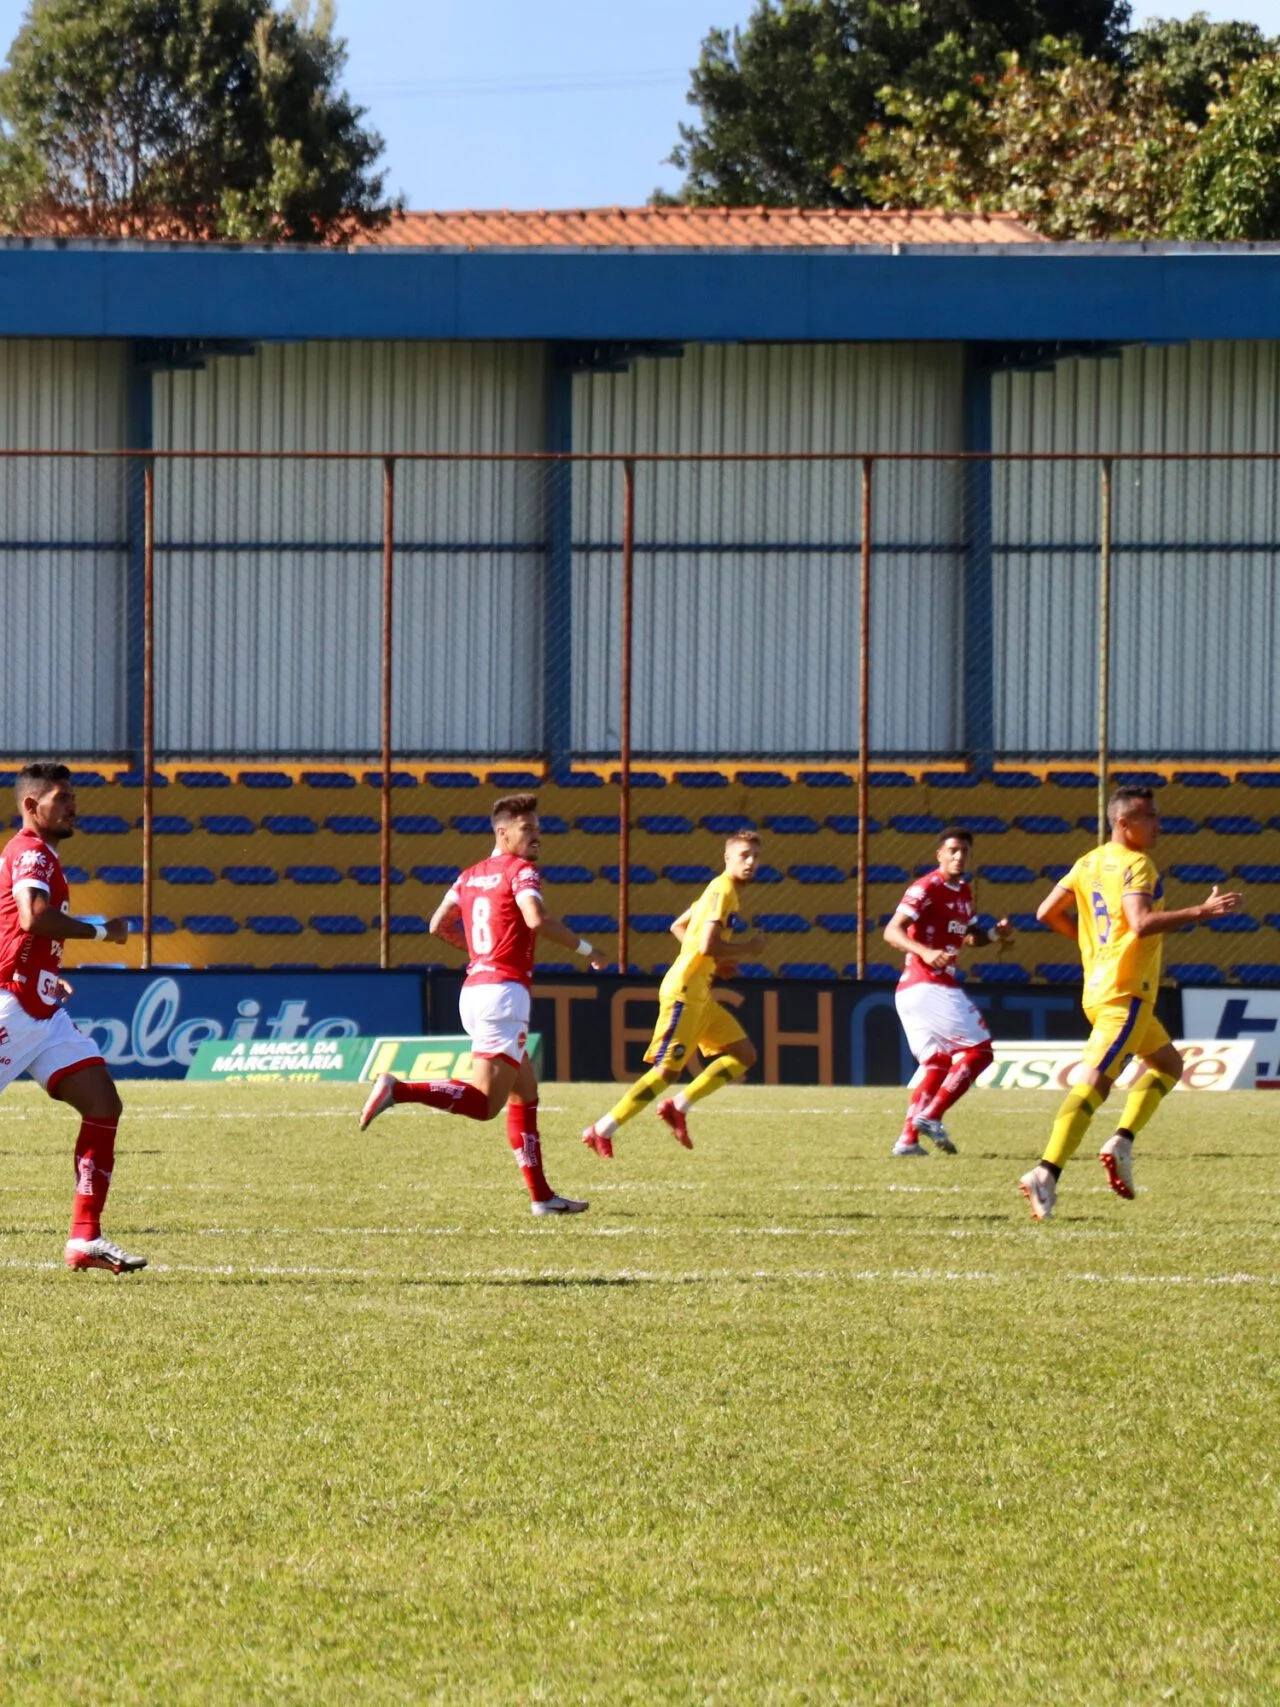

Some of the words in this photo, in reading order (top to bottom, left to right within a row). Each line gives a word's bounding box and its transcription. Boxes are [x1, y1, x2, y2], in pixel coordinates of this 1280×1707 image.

[471, 896, 492, 955] 8
[231, 1042, 246, 1056] A
[249, 1041, 309, 1056] MARCA
[312, 1040, 339, 1054] DA
[530, 984, 1075, 1086] TEHNT
[210, 1054, 345, 1072] MARCENARIA
